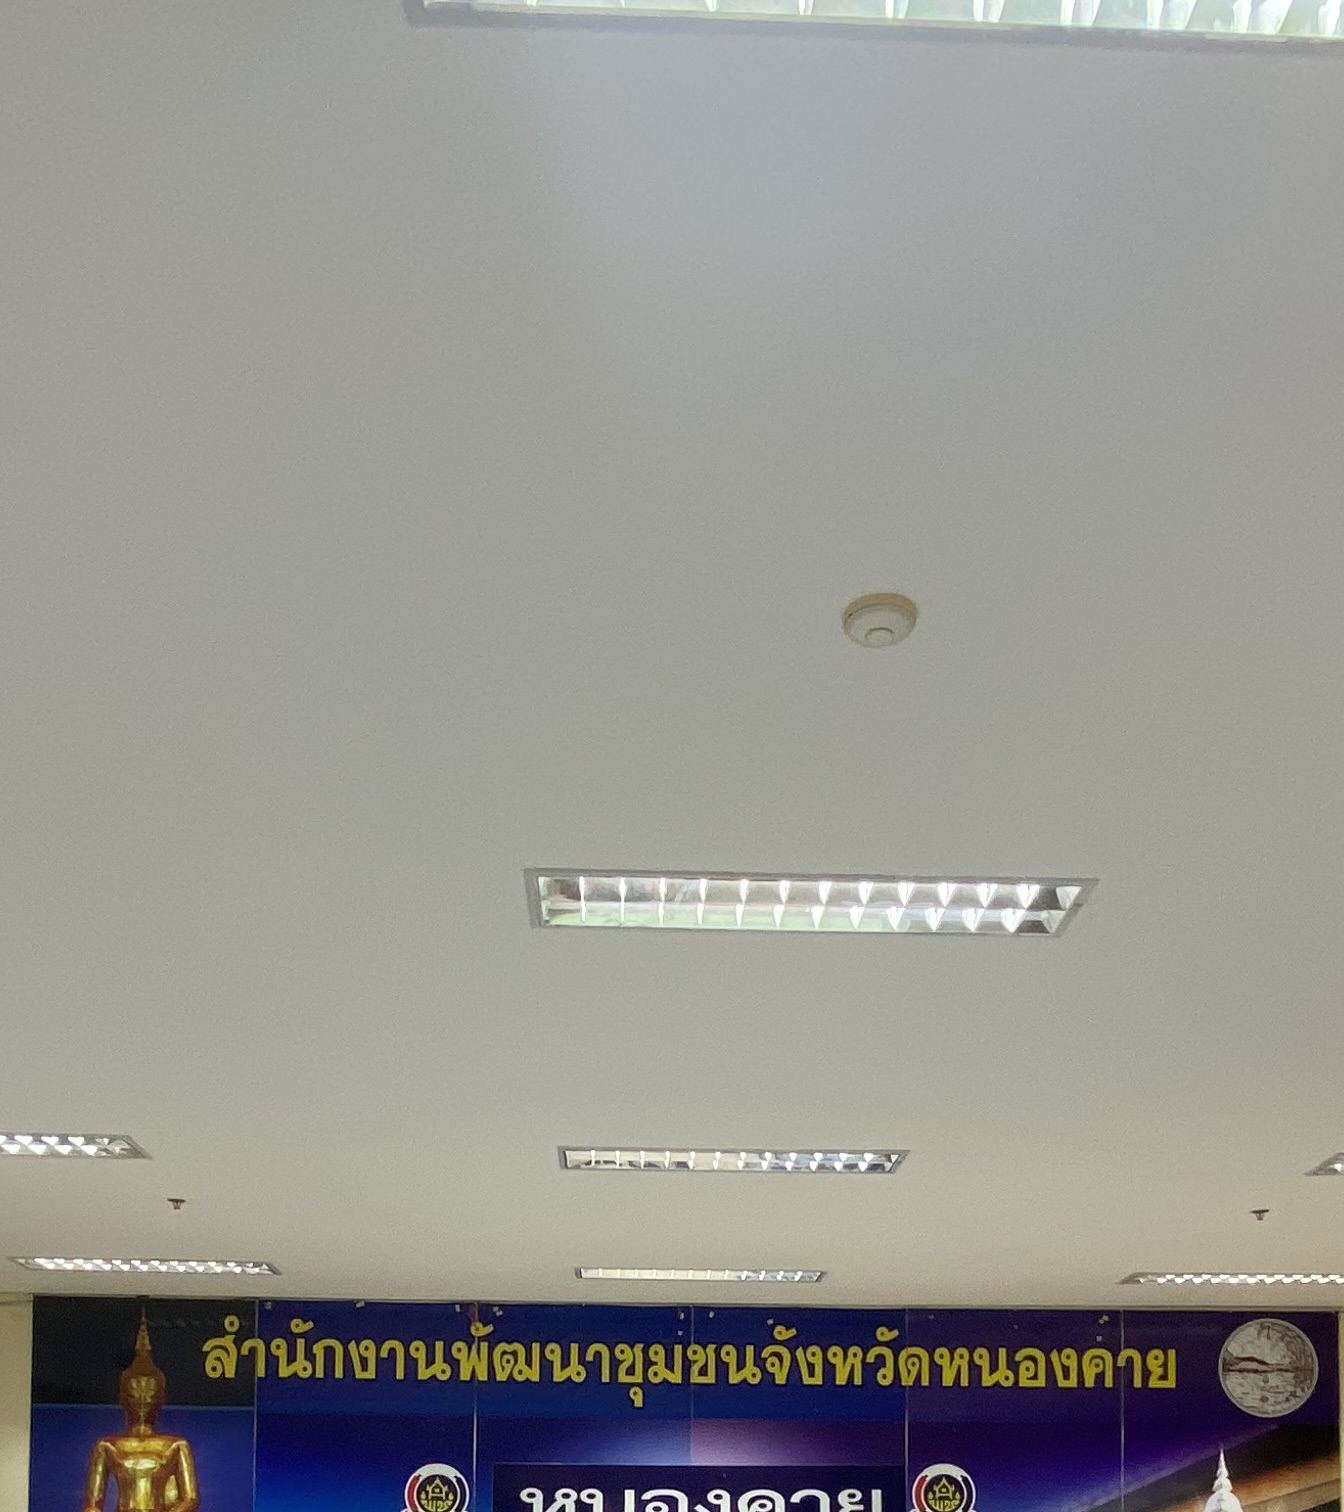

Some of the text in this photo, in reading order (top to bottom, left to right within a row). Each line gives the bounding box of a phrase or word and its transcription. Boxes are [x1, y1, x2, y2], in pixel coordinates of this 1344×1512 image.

[201, 1314, 1178, 1408] สำนักงานพัฒนาชุมชนจังหวัดหนองคาย
